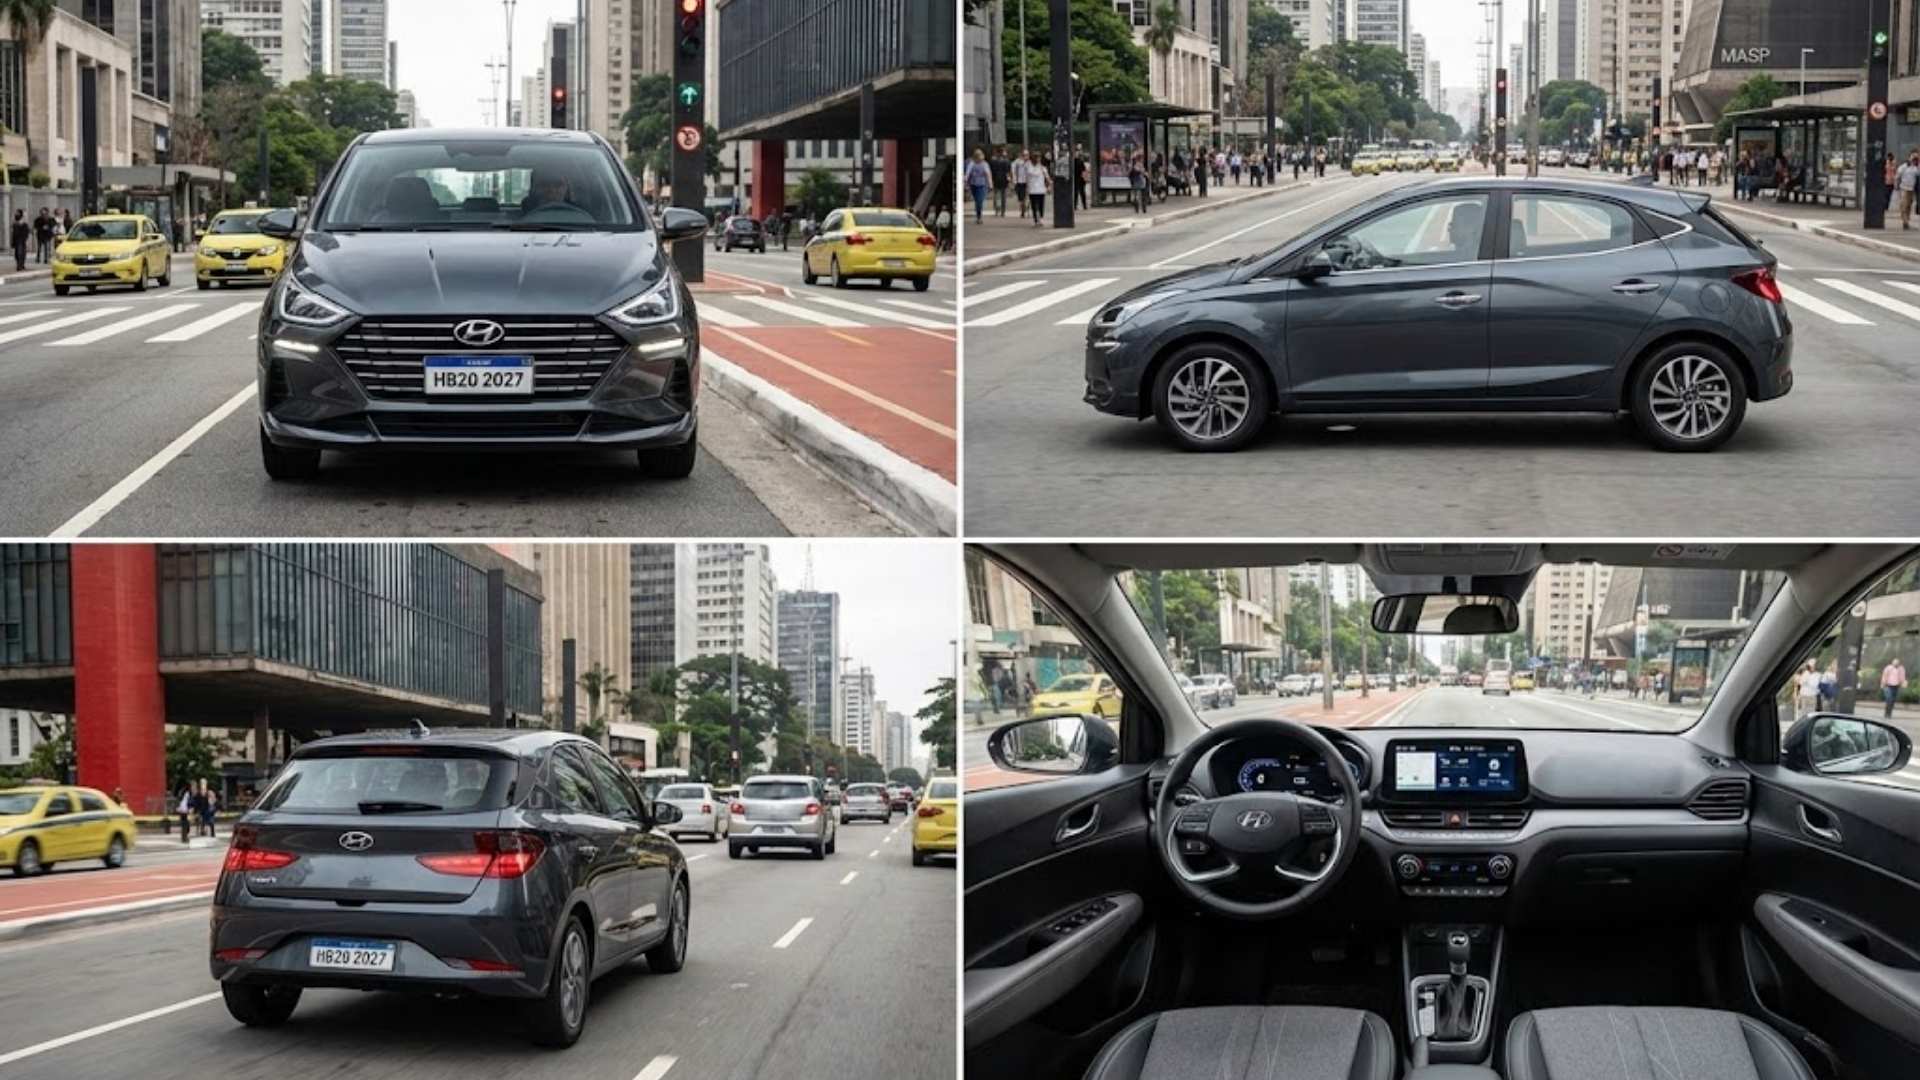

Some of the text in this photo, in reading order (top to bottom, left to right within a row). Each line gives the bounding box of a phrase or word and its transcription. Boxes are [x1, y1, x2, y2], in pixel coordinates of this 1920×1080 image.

[1721, 48, 1770, 64] MASP
[433, 372, 524, 388] HB20 2027
[353, 951, 387, 966] 2027
